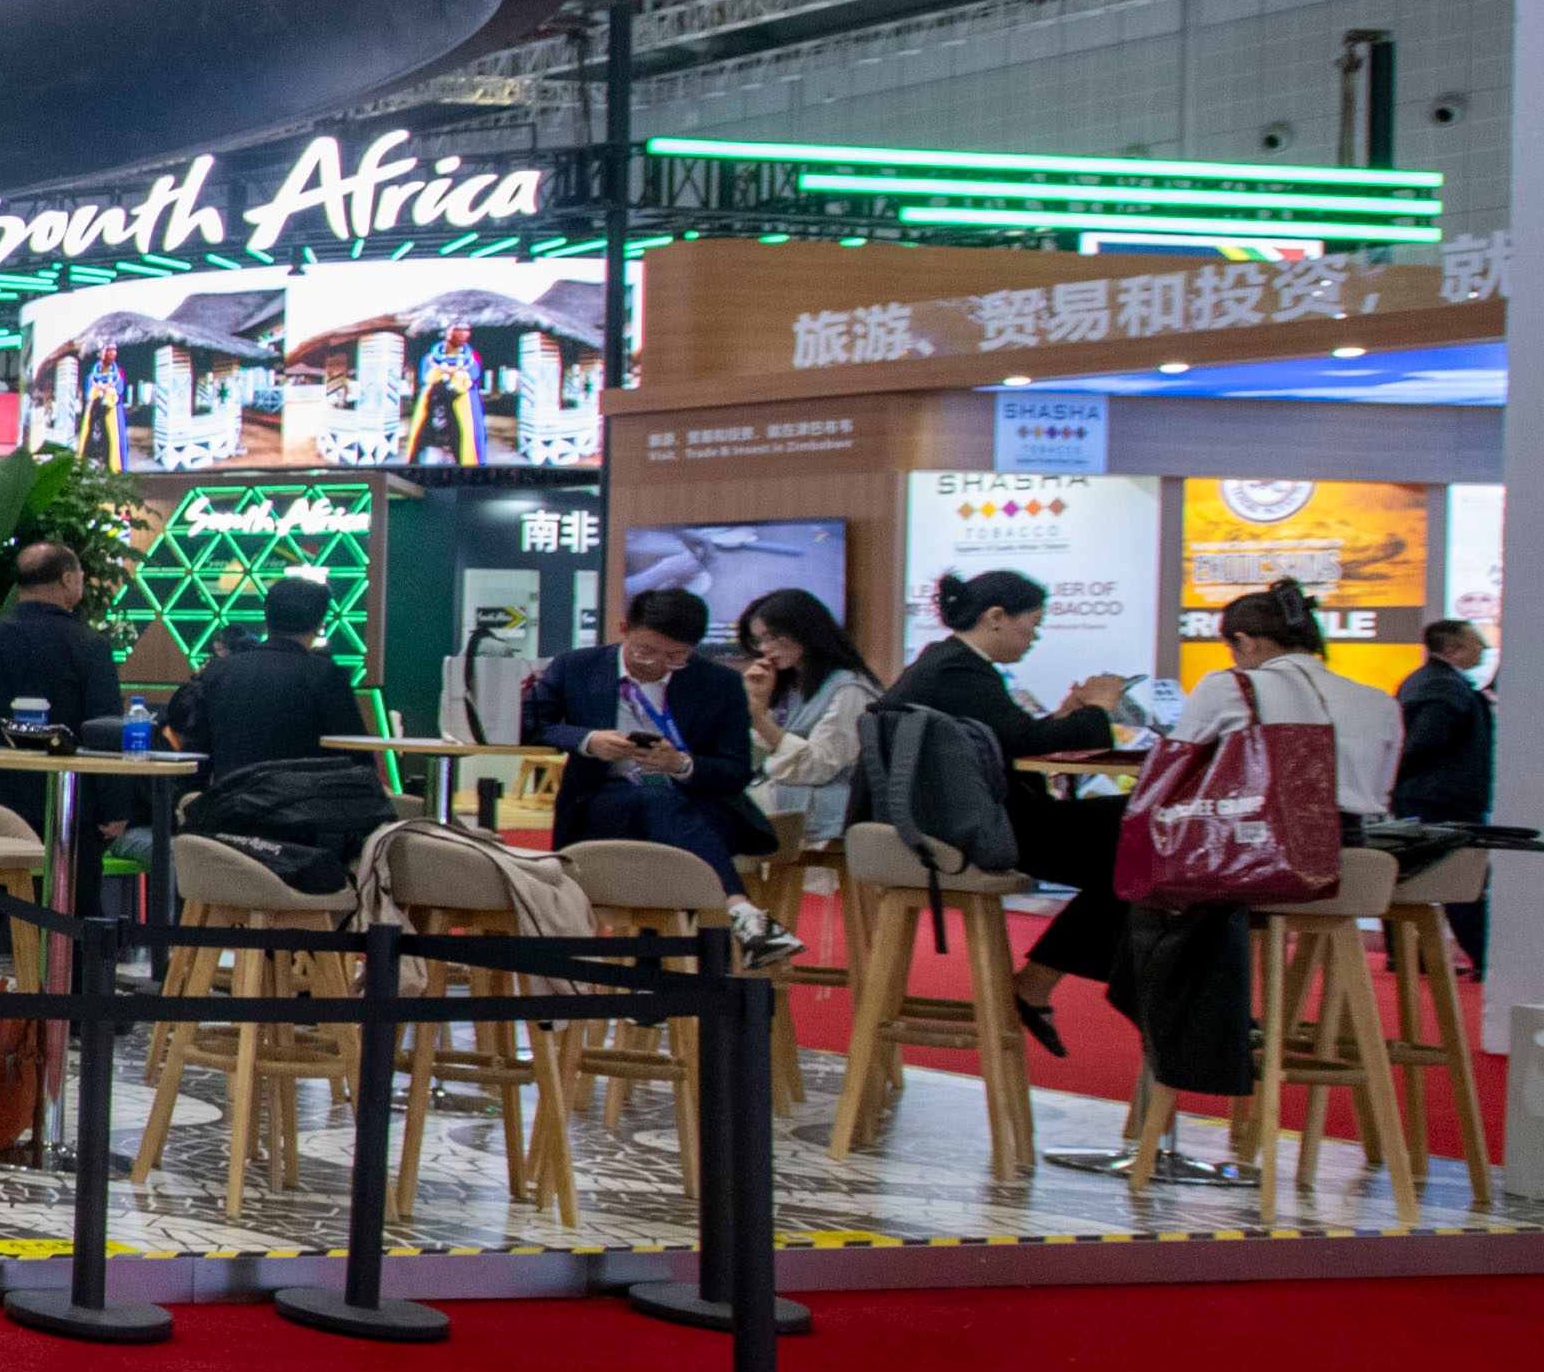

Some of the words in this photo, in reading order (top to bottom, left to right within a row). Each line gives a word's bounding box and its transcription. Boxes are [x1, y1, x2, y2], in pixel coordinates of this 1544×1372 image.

[243, 129, 544, 251] Africa
[1003, 402, 1102, 421] SHASHA
[519, 509, 601, 553] 南非
[1048, 601, 1124, 616] BACCO
